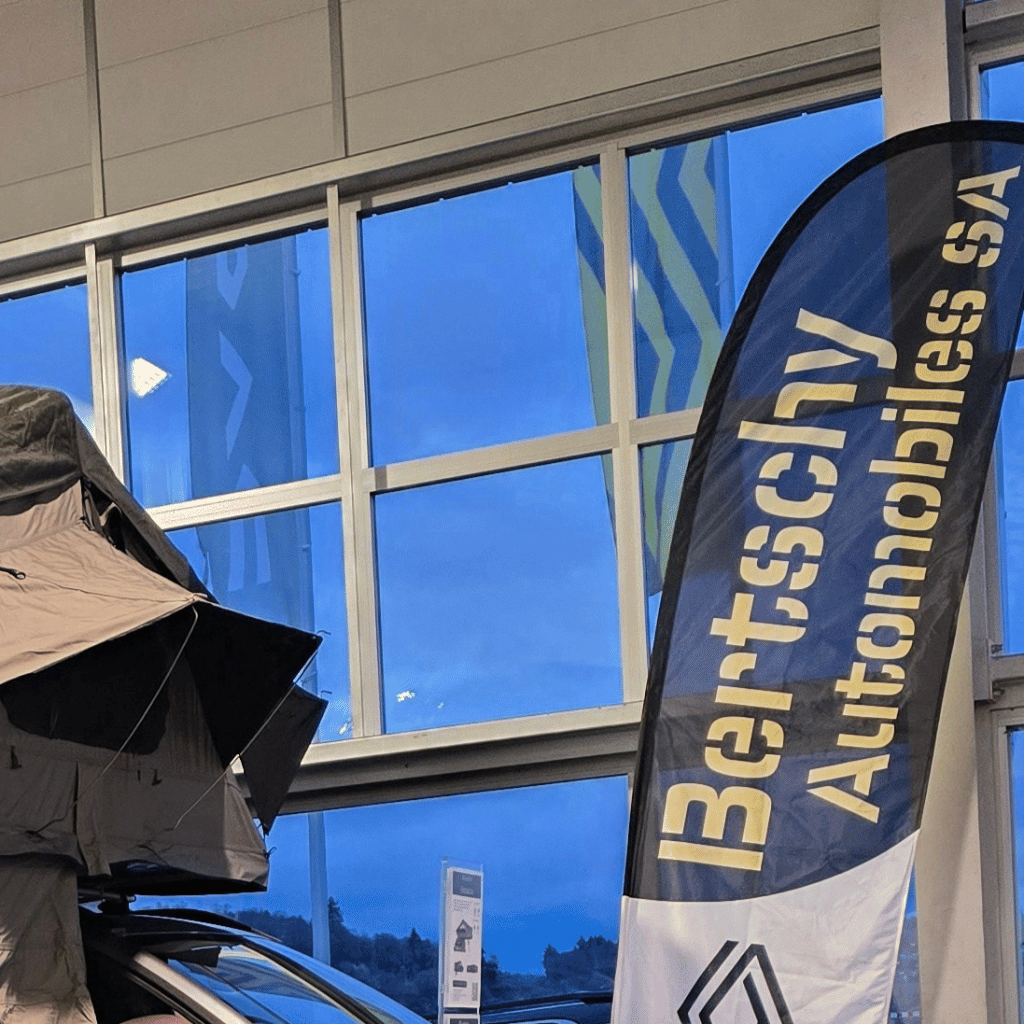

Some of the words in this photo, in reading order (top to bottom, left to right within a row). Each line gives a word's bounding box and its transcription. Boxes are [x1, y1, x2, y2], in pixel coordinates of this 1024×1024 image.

[658, 307, 897, 872] Bertschy
[806, 289, 987, 824] Automobiles
[941, 165, 1021, 268] SA
